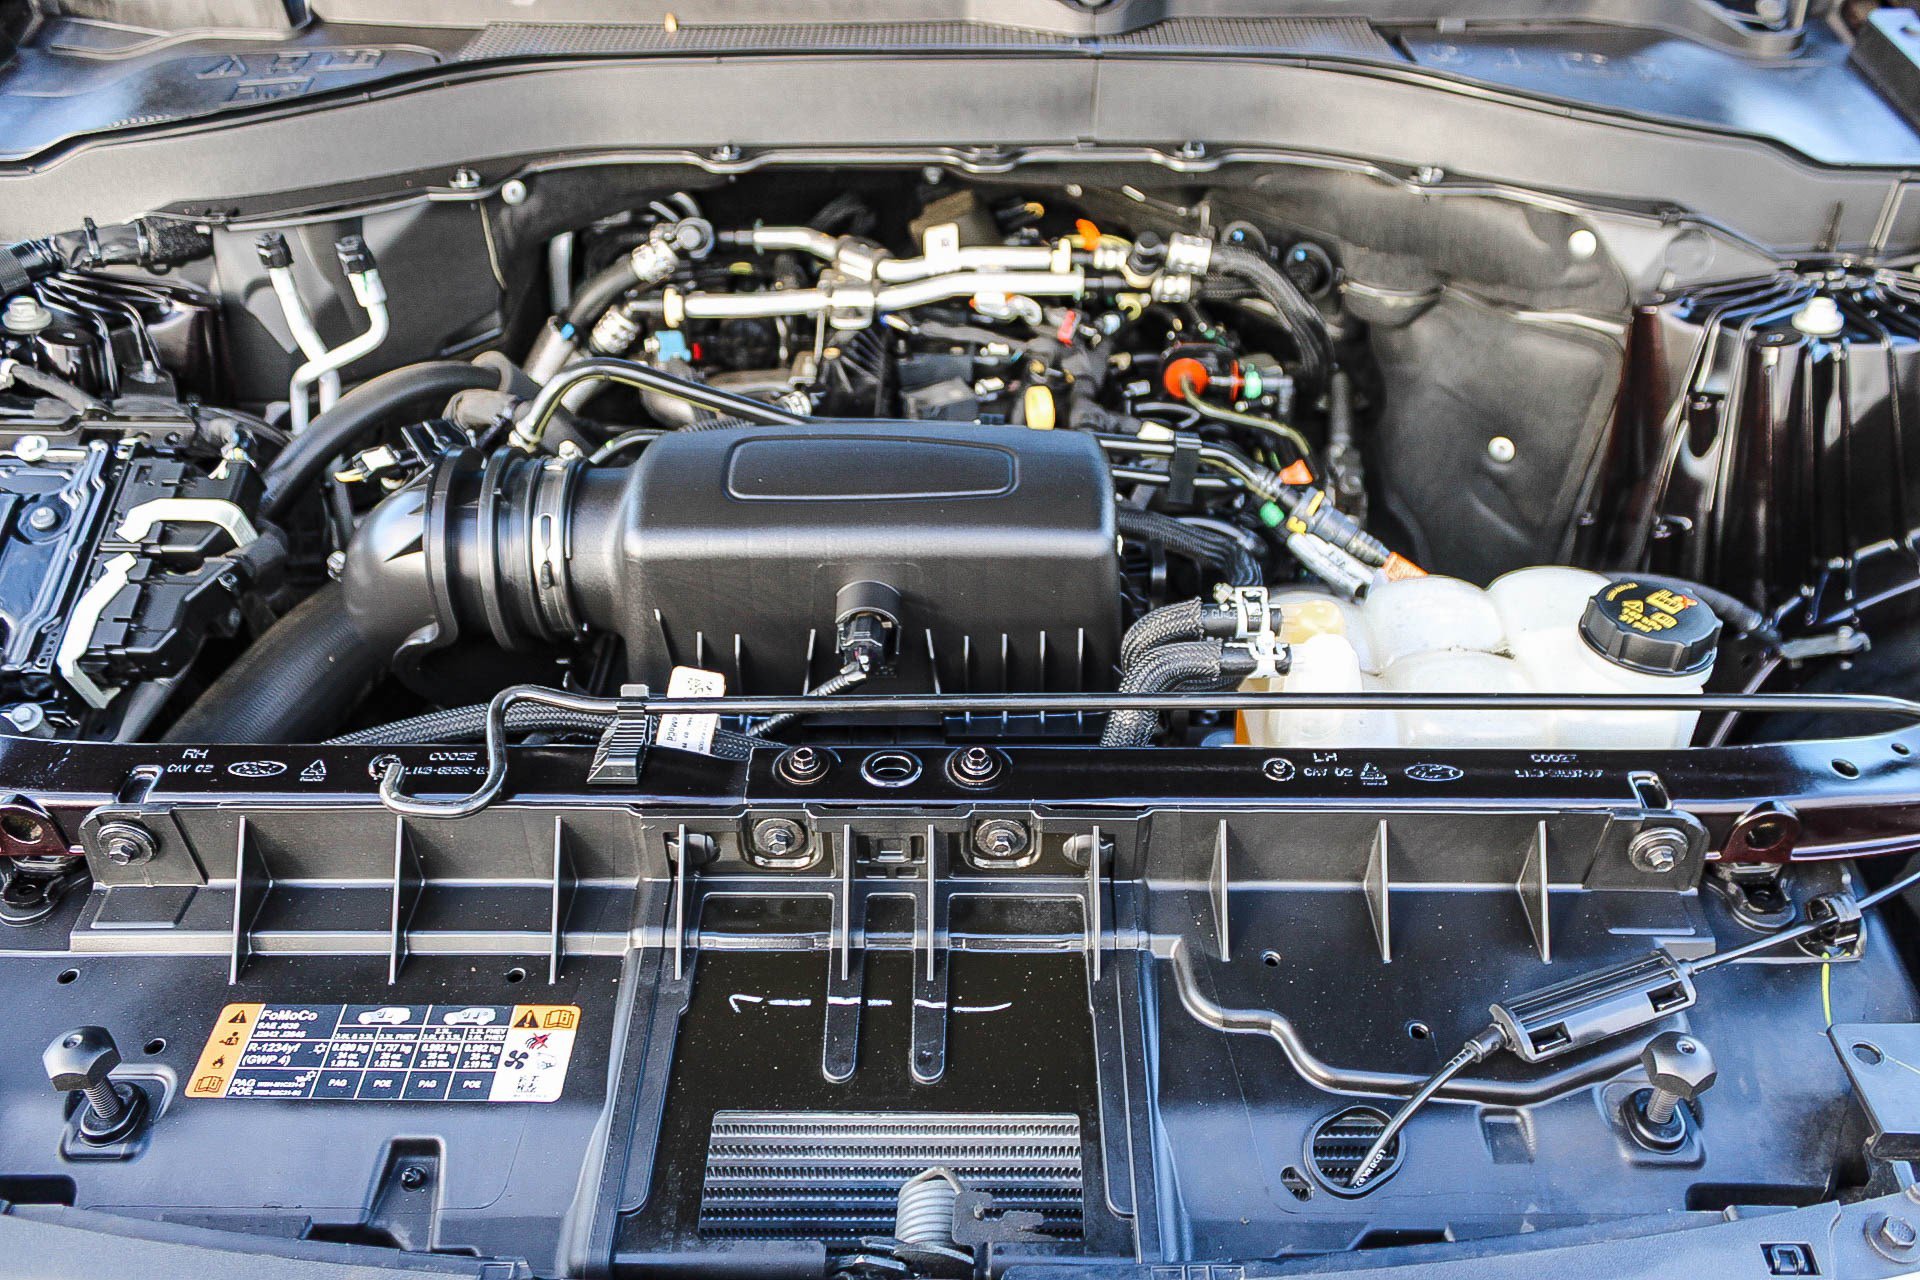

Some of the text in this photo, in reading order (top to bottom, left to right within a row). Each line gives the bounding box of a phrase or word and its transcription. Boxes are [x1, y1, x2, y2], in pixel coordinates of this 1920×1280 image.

[182, 748, 209, 759] RH
[1313, 752, 1338, 763] LH
[260, 1009, 318, 1021] FoMoCo
[247, 1043, 301, 1054] R-1234yf
[242, 1055, 291, 1066] (GWP 4)
[231, 1078, 256, 1087] PAG
[328, 1078, 348, 1087] PAG
[372, 1079, 393, 1088] POE
[417, 1079, 437, 1088] PAG
[462, 1080, 482, 1089] POE
[228, 1086, 253, 1096] POE
